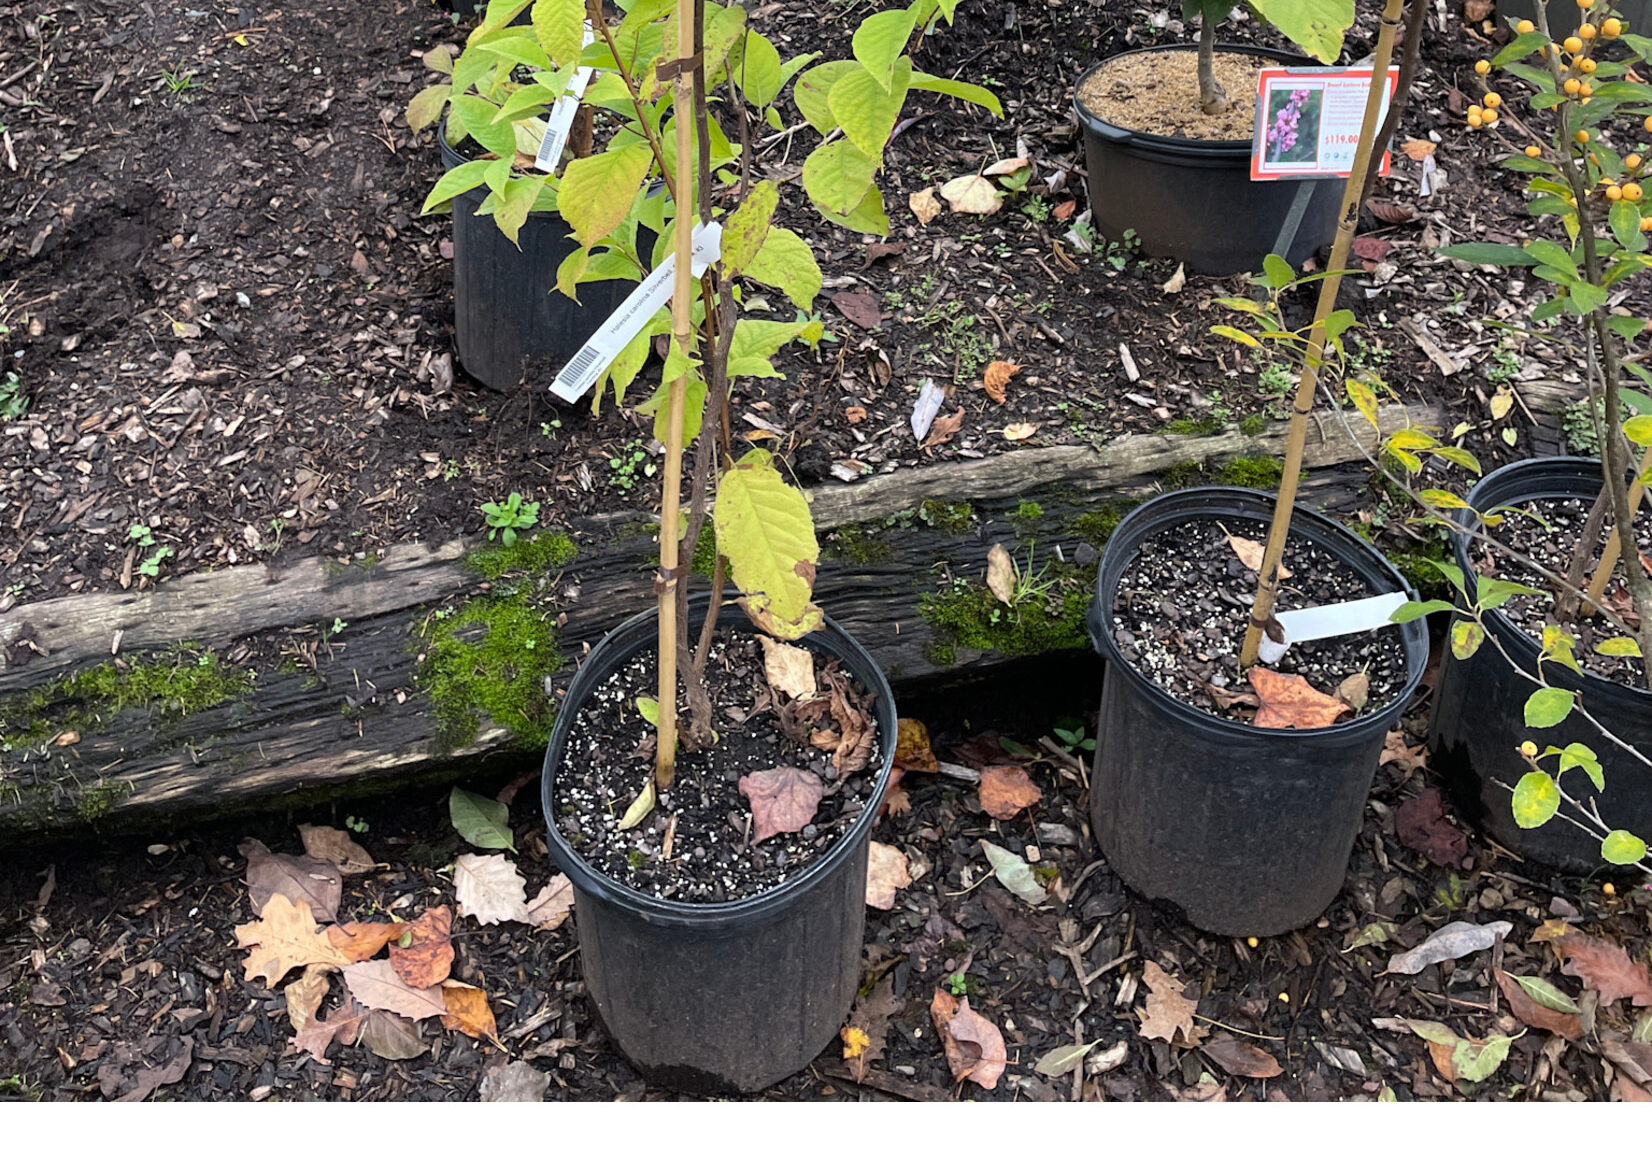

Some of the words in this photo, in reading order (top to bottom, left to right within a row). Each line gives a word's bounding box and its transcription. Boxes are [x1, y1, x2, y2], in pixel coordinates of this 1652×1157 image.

[1325, 134, 1359, 145] $119.00
[610, 314, 631, 334] Halesia
[629, 293, 651, 315] carolina
